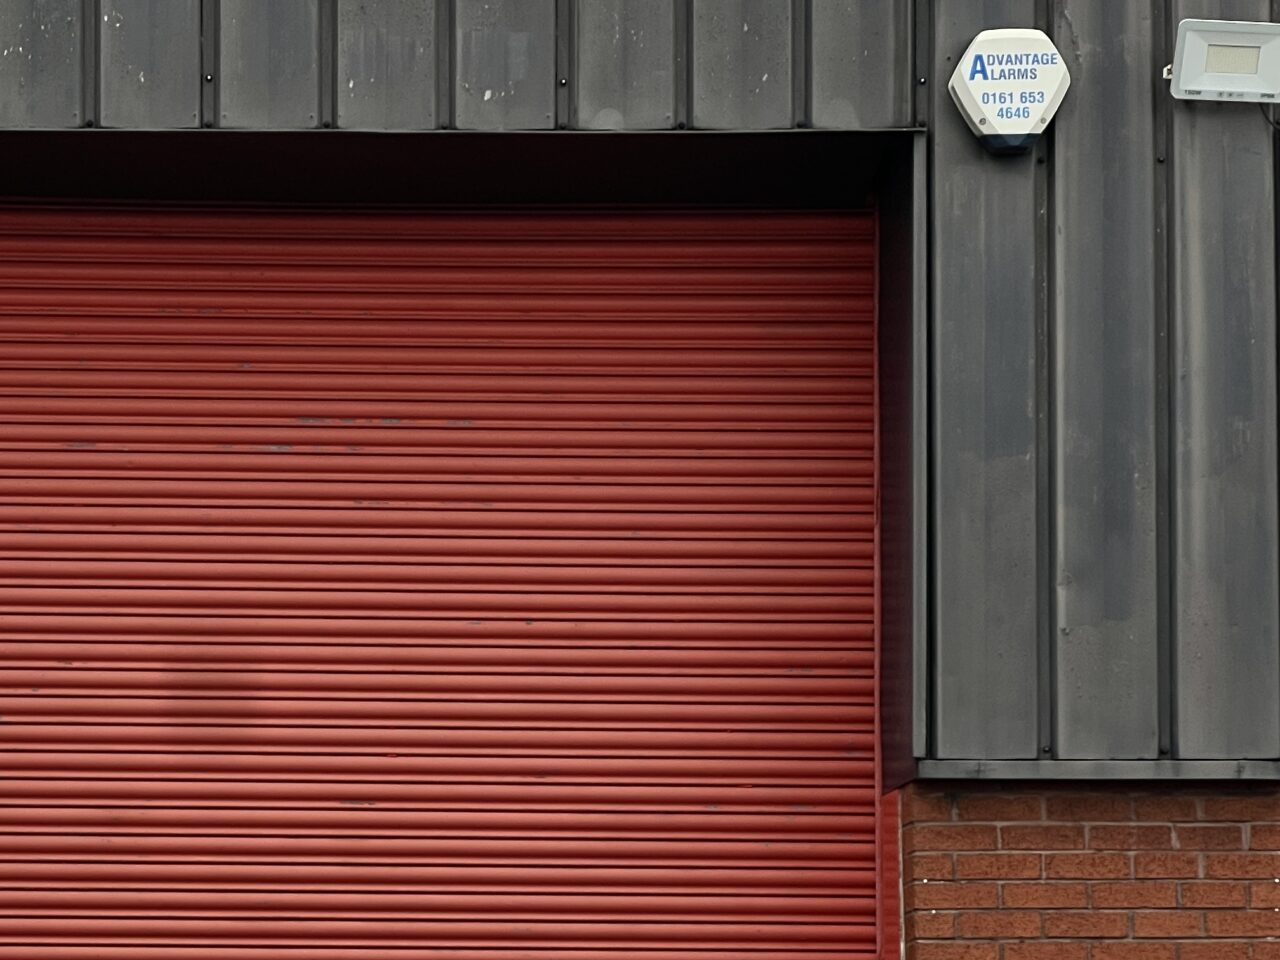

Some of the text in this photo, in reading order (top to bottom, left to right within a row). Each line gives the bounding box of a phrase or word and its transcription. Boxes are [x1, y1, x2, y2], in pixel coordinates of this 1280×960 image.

[982, 91, 1045, 104] 0161 653
[997, 107, 1030, 119] 4646
